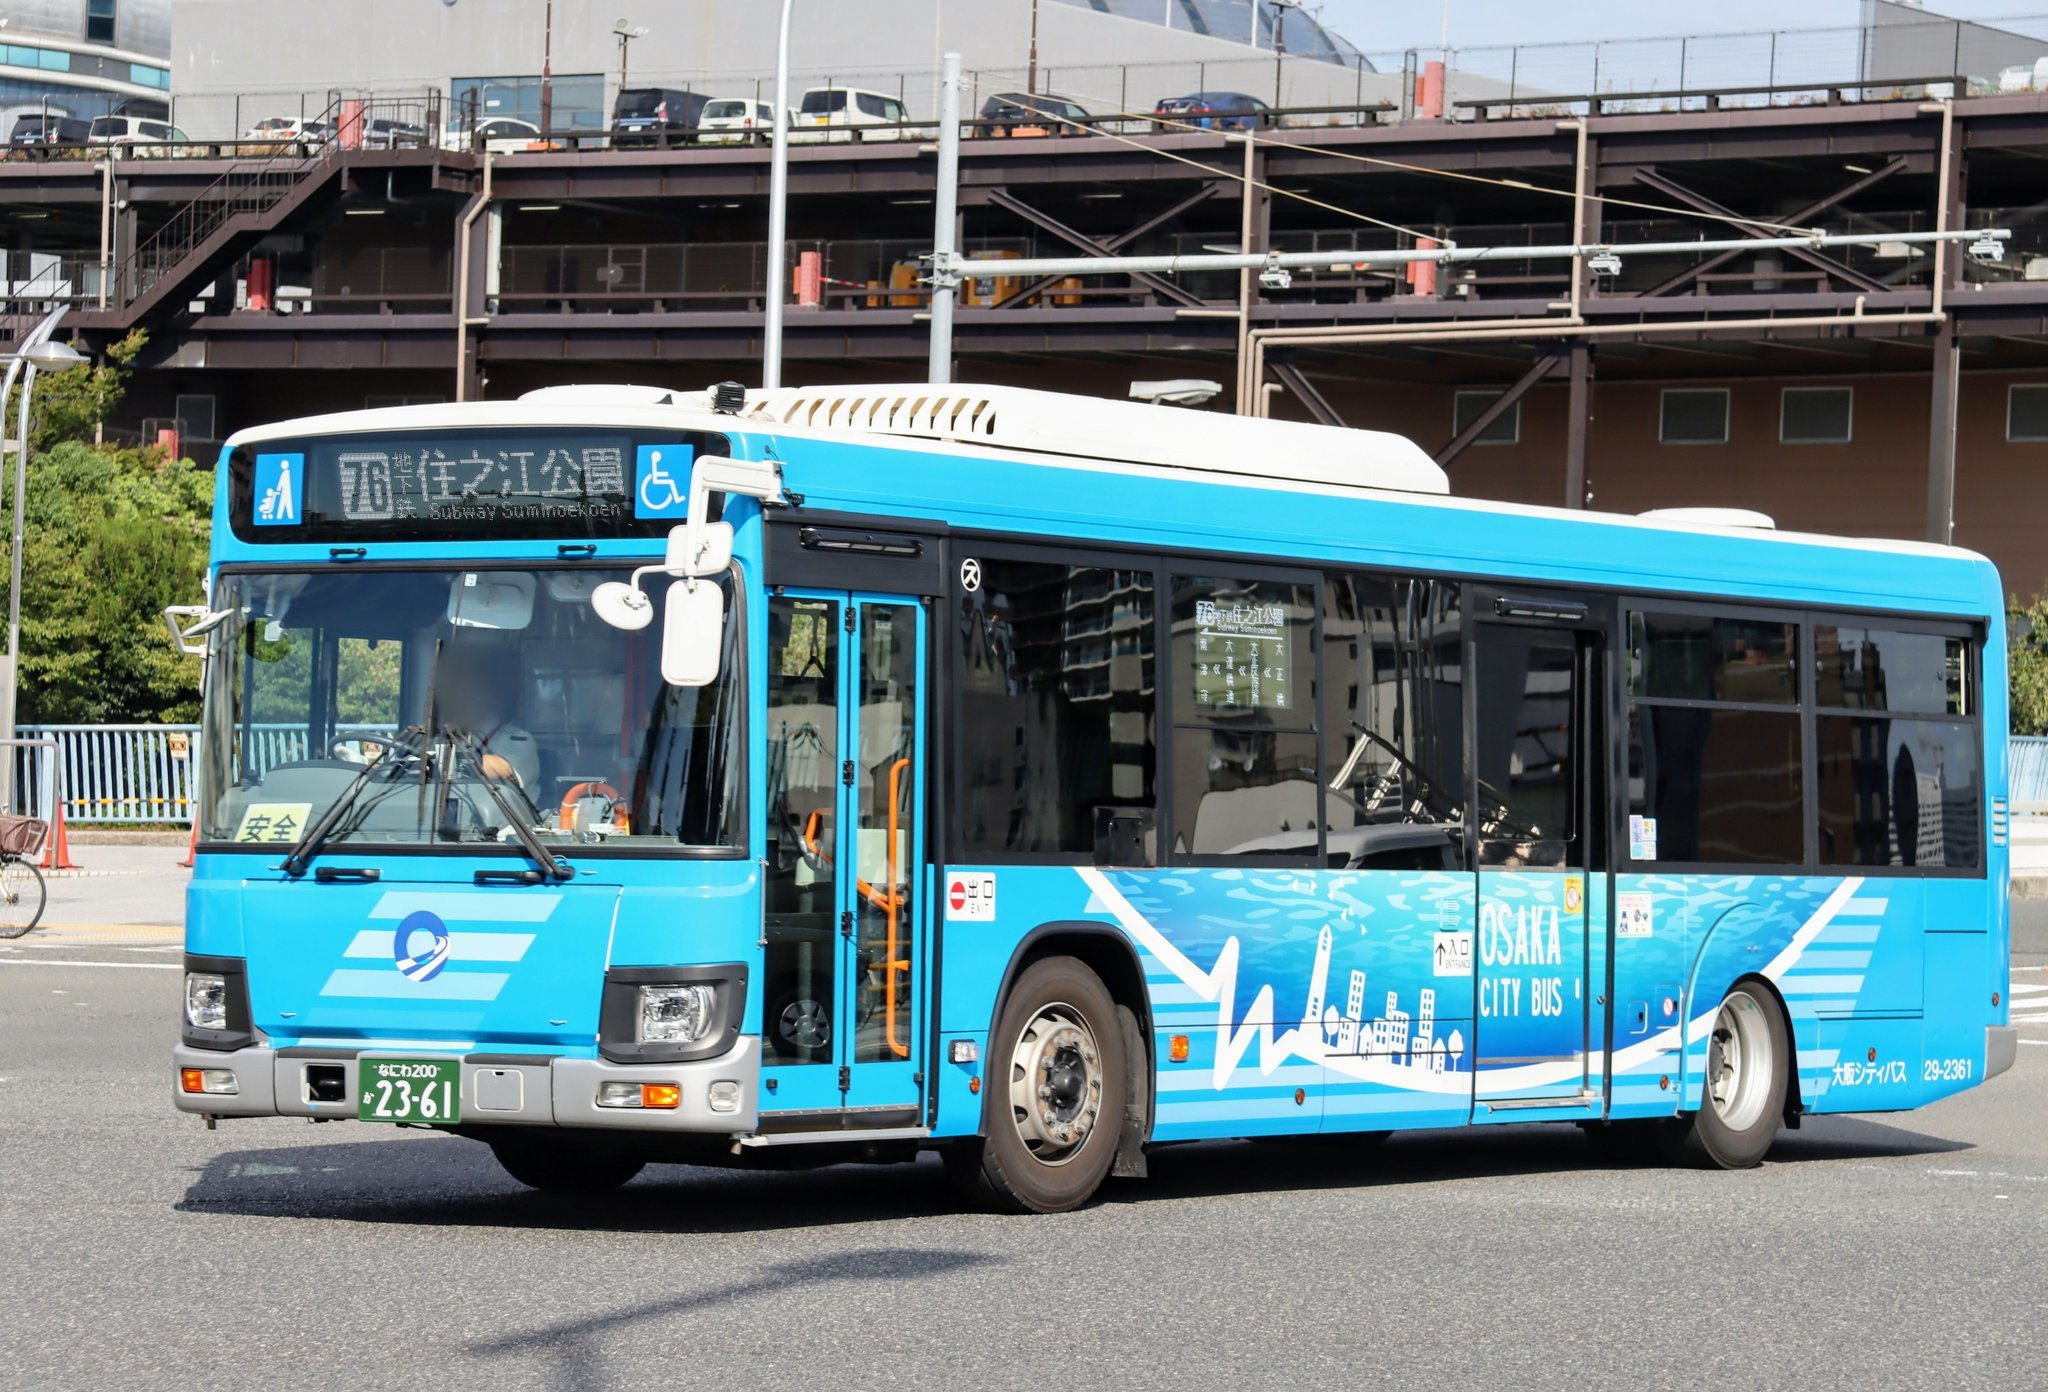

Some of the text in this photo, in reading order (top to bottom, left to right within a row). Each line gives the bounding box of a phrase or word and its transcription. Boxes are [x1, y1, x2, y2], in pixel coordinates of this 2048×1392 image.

[341, 455, 391, 517] 76
[417, 448, 624, 501] 住之江公園
[430, 501, 621, 521] Subway Suminoekoen
[1197, 602, 1214, 624] 76
[241, 814, 297, 842] 安全
[968, 880, 993, 899] 出口
[1449, 939, 1469, 956] 入口
[1480, 903, 1562, 966] OSAKA
[1480, 977, 1563, 1017] CITY BUS
[1832, 1059, 1973, 1086] 大阪シティバス 29-2361
[375, 1080, 452, 1119] 23-61
